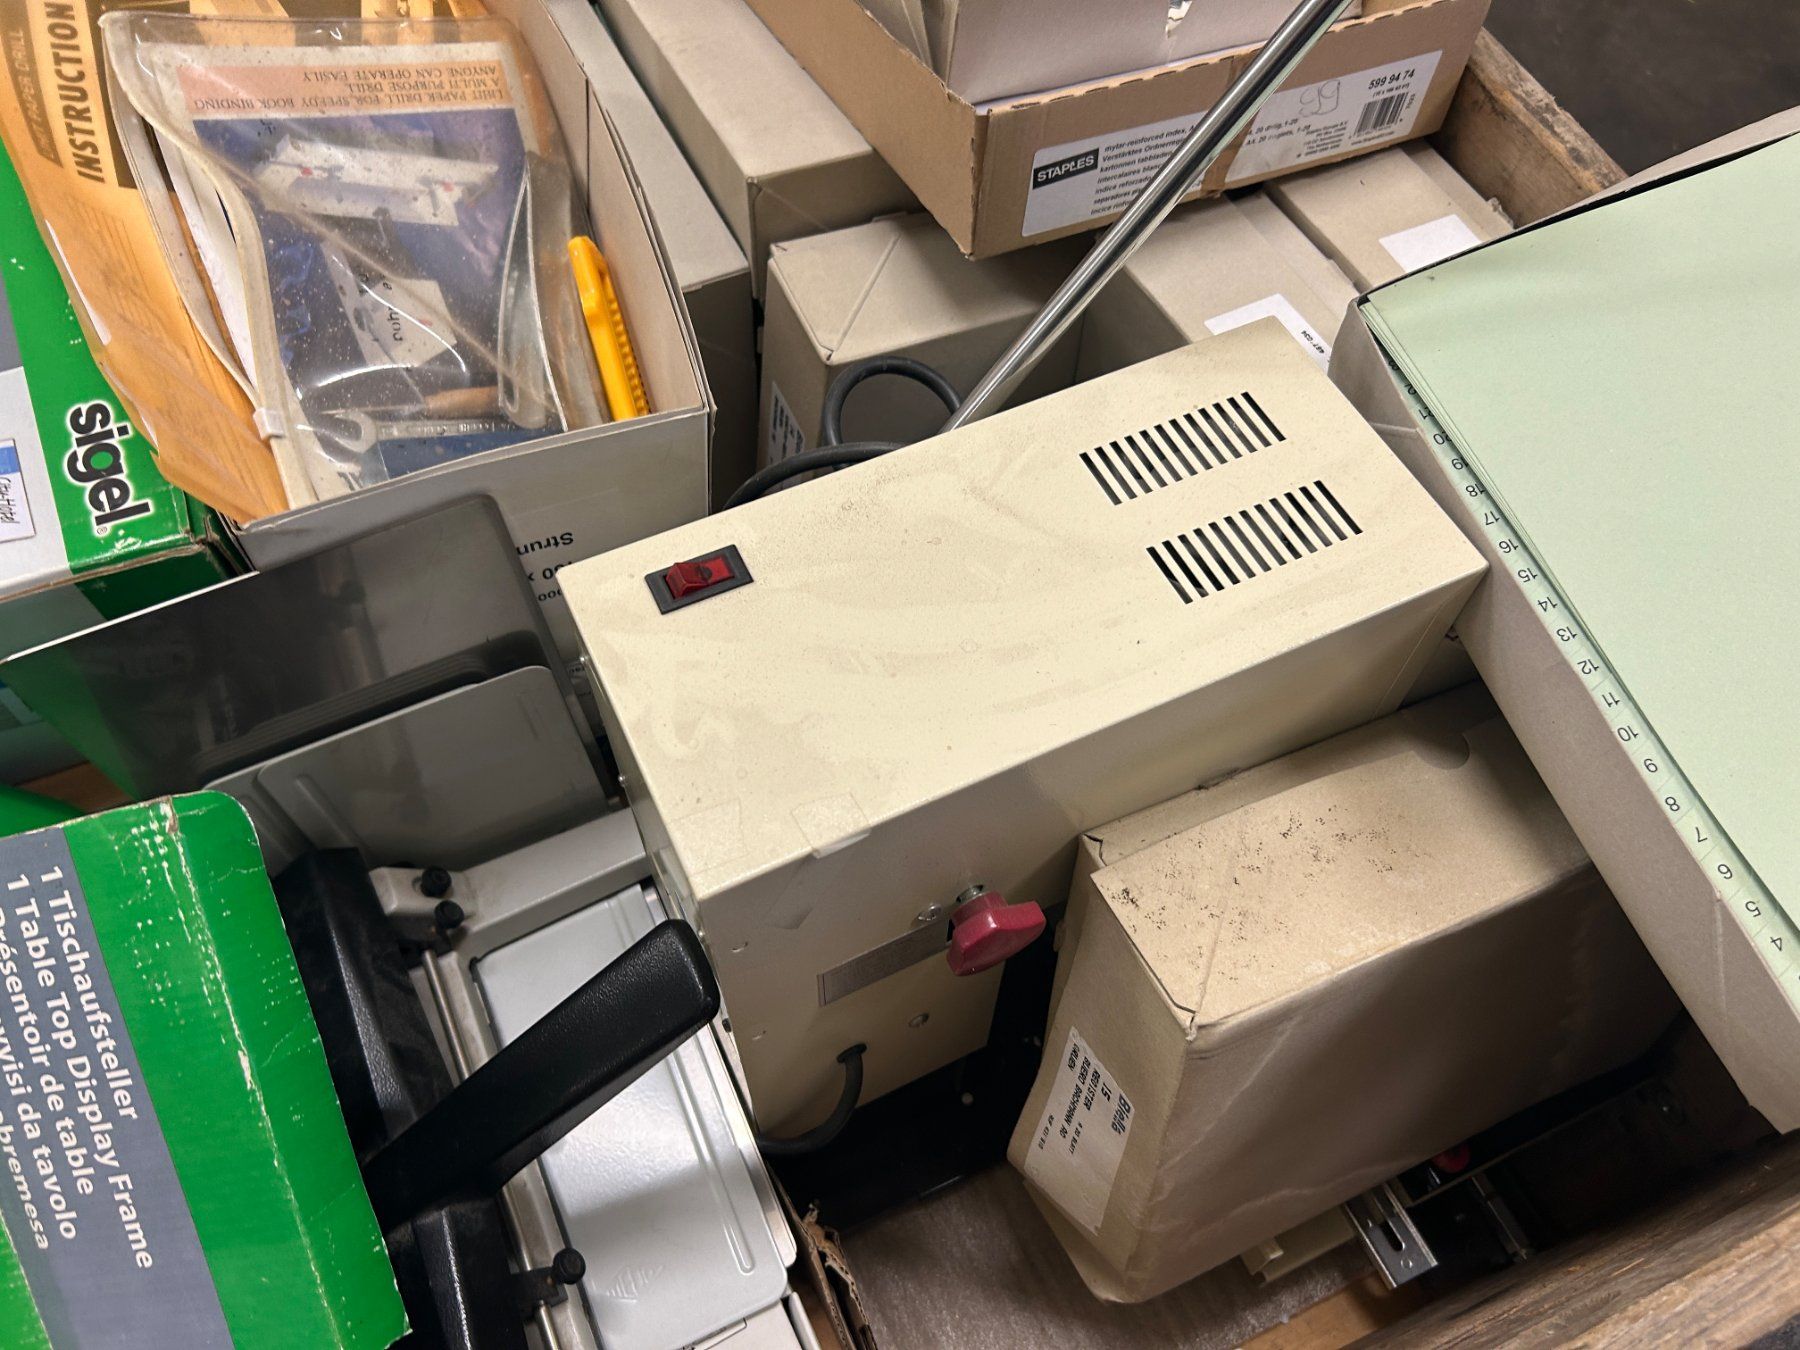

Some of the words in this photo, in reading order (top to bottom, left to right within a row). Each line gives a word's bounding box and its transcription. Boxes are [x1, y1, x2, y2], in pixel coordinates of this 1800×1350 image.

[302, 69, 349, 82] EASILY
[355, 68, 411, 81] OPERATE
[415, 67, 442, 79] CAN
[447, 65, 497, 78] ANYONE
[388, 79, 444, 92] PURPOSE
[448, 78, 489, 90] MULTI
[492, 77, 500, 88] A
[44, 1, 106, 184] INSTRUCTION
[355, 94, 381, 107] FOR
[388, 93, 422, 105] DRILL
[424, 91, 464, 104] PAPER
[193, 97, 255, 110] BINDING
[258, 98, 294, 110] BOOK
[1036, 154, 1095, 183] STAPLES
[66, 402, 151, 527] sigel
[1465, 483, 1485, 498] 18
[1483, 510, 1501, 526] 17
[1498, 538, 1519, 554] 16
[1517, 567, 1538, 583] 15
[1537, 596, 1558, 612] 14
[1556, 626, 1578, 642] 13
[1577, 658, 1600, 675] 12
[1601, 691, 1621, 708] 11
[1616, 724, 1640, 743] 10
[1643, 758, 1659, 774] 9
[1664, 795, 1681, 812] 8
[1694, 826, 1708, 843] 7
[40, 865, 63, 883] 1
[1716, 863, 1734, 880] 6
[7, 873, 30, 890] 1
[1744, 900, 1762, 918] 5
[15, 897, 57, 988] Table
[1769, 935, 1784, 952] 4
[48, 889, 138, 1120] Tischaufsteller
[46, 991, 77, 1050] Top
[1077, 1056, 1091, 1085] BUERO
[1083, 1068, 1101, 1111] REGISTER
[66, 1055, 120, 1168] Display
[1111, 1094, 1132, 1136] Biella
[39, 1074, 66, 1112] de
[55, 1116, 96, 1195] table
[17, 1102, 42, 1140] da
[32, 1144, 78, 1240] tavolo
[107, 1173, 153, 1269] Frame
